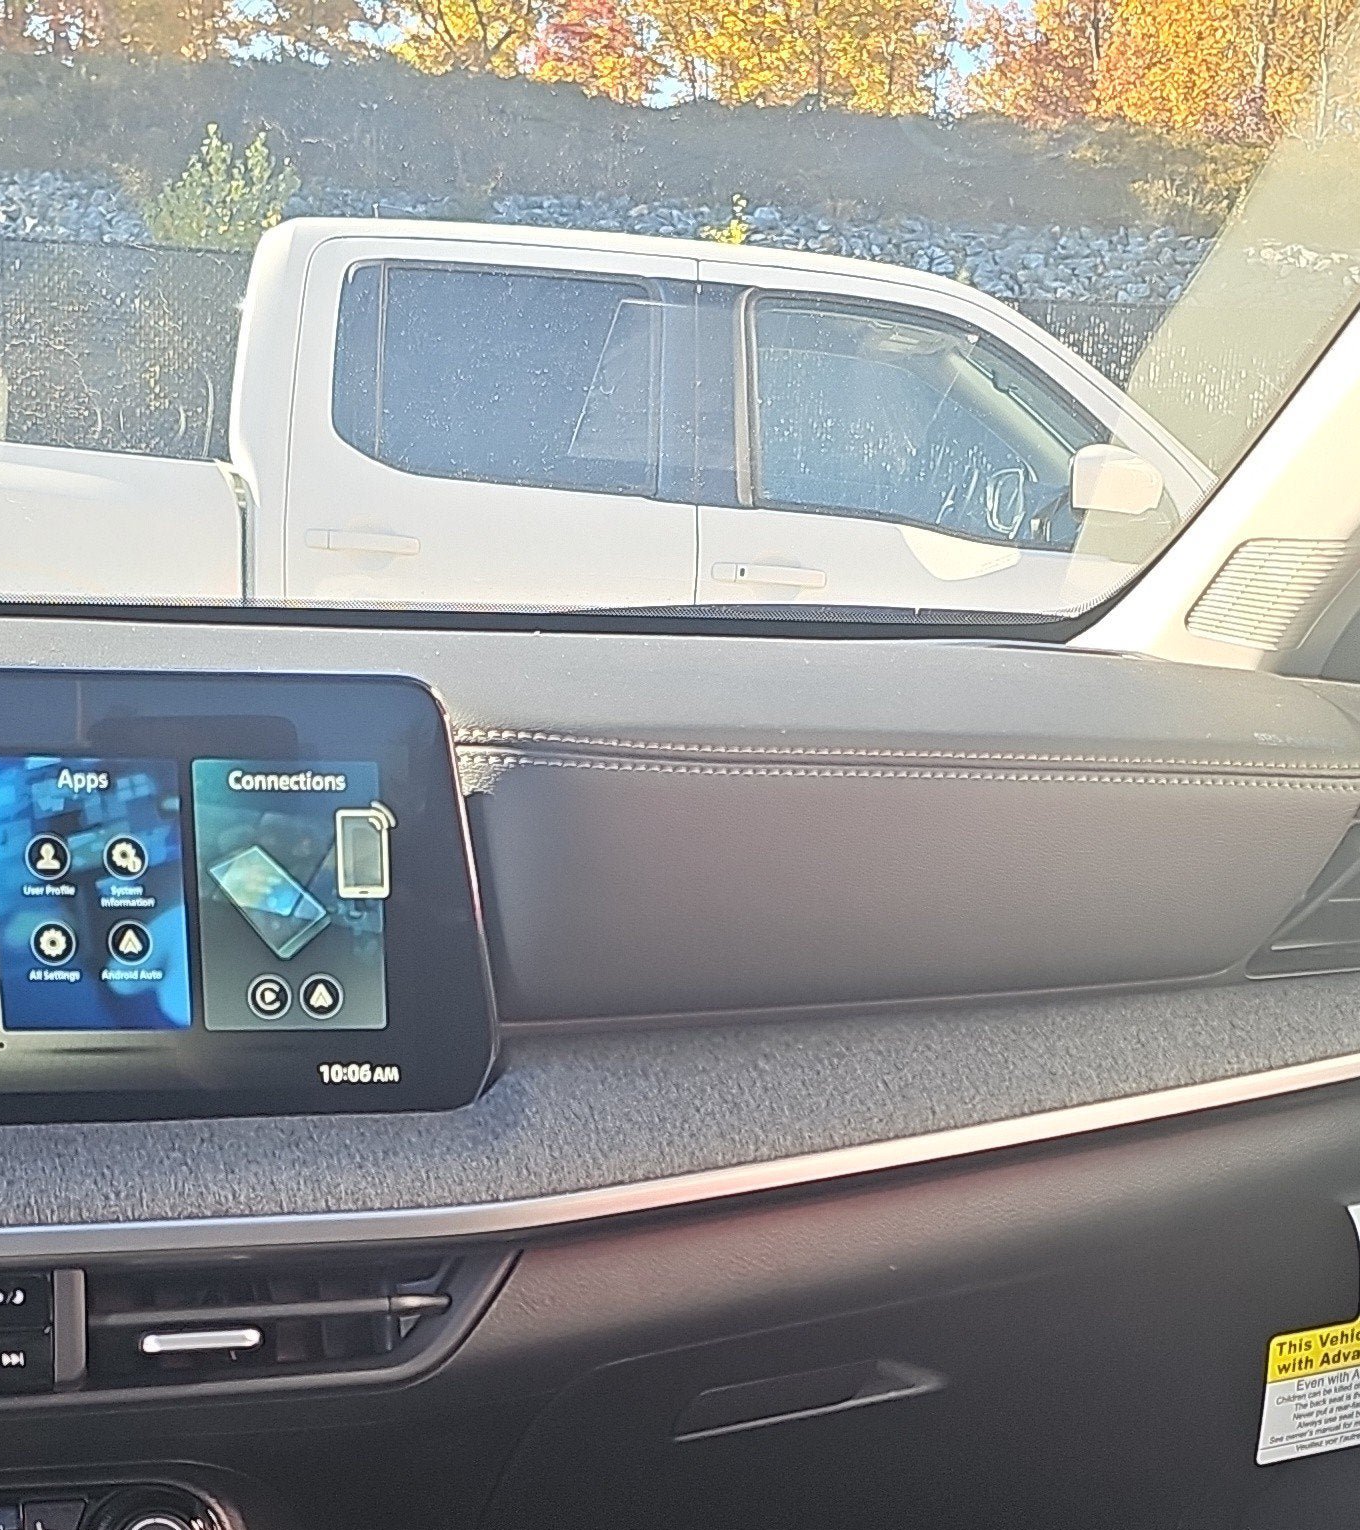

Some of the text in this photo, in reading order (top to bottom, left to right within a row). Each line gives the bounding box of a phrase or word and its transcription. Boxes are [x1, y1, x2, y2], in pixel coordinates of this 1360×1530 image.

[57, 769, 109, 792] Apps
[228, 770, 346, 791] Connections
[319, 1064, 400, 1083] 10:06 AM
[1276, 1338, 1313, 1357] This
[1277, 1356, 1314, 1376] with
[1296, 1377, 1325, 1392] Even
[1328, 1371, 1350, 1386] with
[1276, 1393, 1307, 1406] Children
